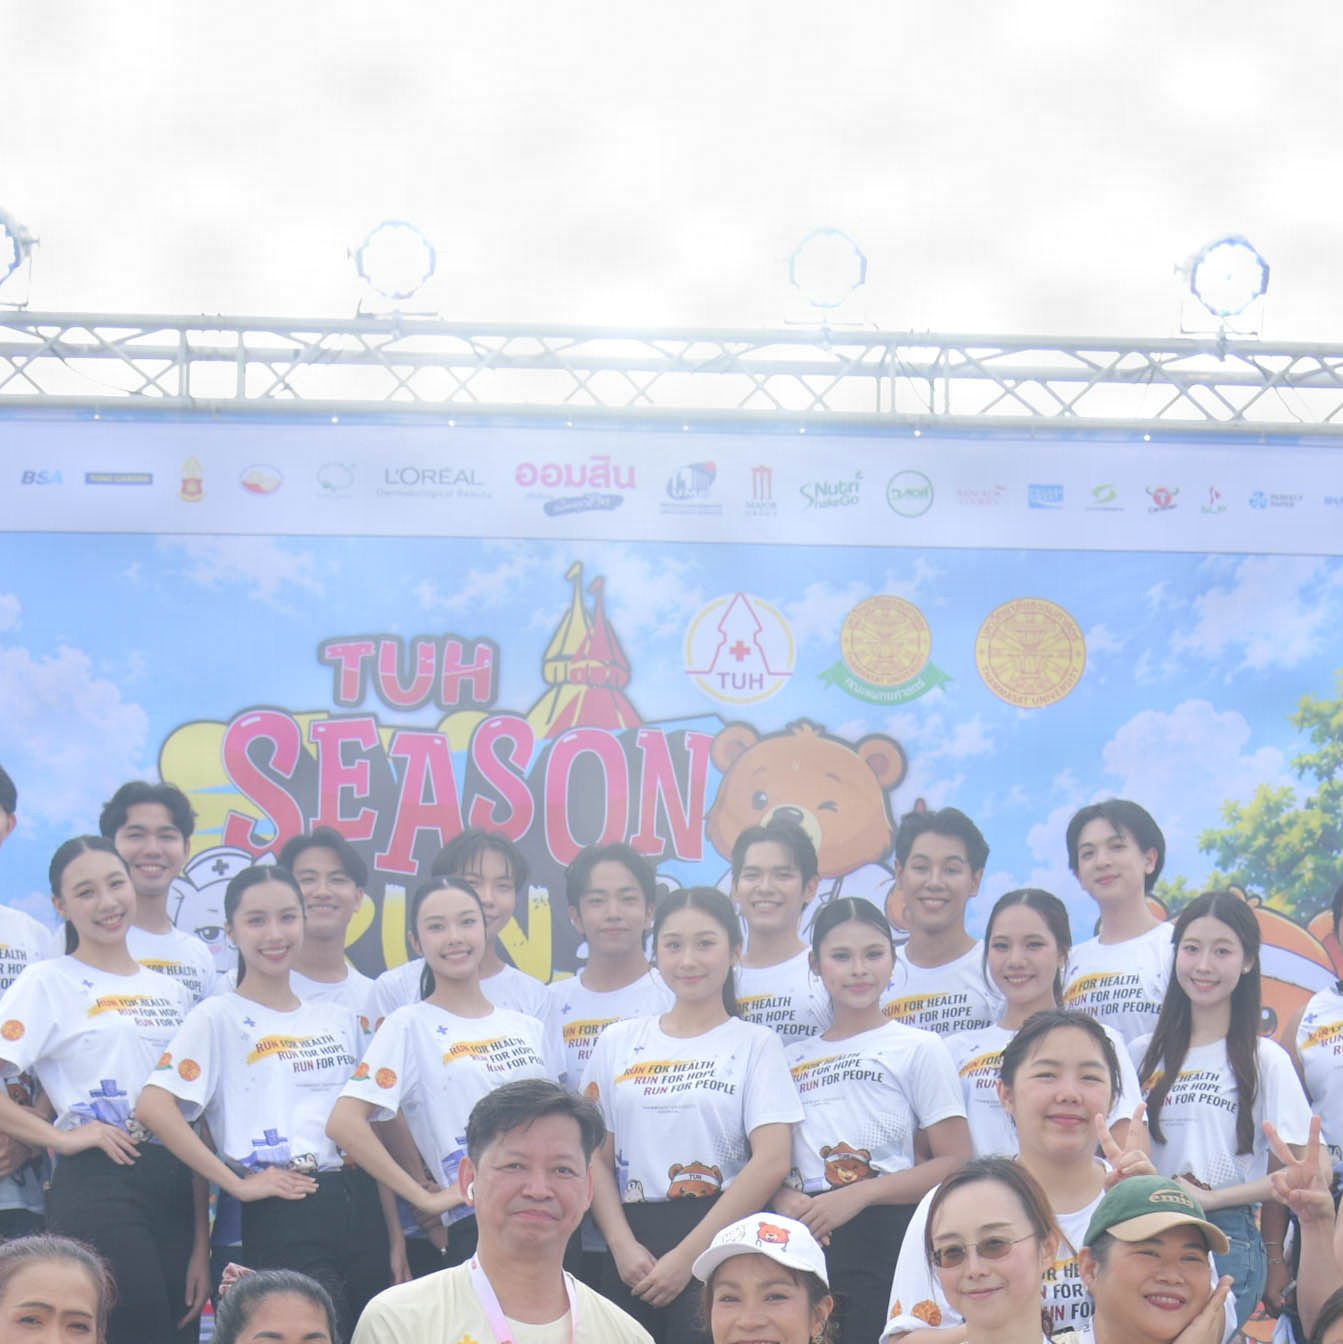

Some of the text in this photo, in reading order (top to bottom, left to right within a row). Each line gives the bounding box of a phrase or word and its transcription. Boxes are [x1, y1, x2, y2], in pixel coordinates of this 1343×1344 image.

[20, 470, 64, 485] BSA
[514, 455, 637, 489] ออมสิน
[323, 638, 499, 709] TUH
[716, 671, 765, 691] TUH
[222, 710, 716, 875] SEASON
[166, 965, 197, 977] HEALTH
[1078, 973, 1140, 991] FOR HEALTH
[751, 996, 792, 1010] HEALTH
[903, 994, 968, 1012] FOR HEALTH
[1090, 987, 1144, 1003] FOR HOPE
[765, 1010, 797, 1022] HOPE
[919, 1006, 972, 1023] FOR HOPE
[1100, 1001, 1162, 1015] FOR PEOPLE
[578, 1023, 601, 1036] FOR
[775, 1023, 818, 1037] PEOPLE
[255, 1034, 335, 1054] RUN HEALTH
[568, 1037, 590, 1049] RUN
[292, 1057, 336, 1073] RUN FOR
[488, 1051, 510, 1063] FOR
[506, 1058, 528, 1071] FOR
[672, 1060, 715, 1073] HEALTH
[633, 1069, 717, 1085] RUN FOR HOPE
[799, 1070, 884, 1094] RUN FOR PEOPLE
[643, 1079, 737, 1096] RUN FOR PEOPLE
[1190, 1081, 1222, 1094] HOPE
[1174, 1092, 1239, 1114] FOR PEOPLE
